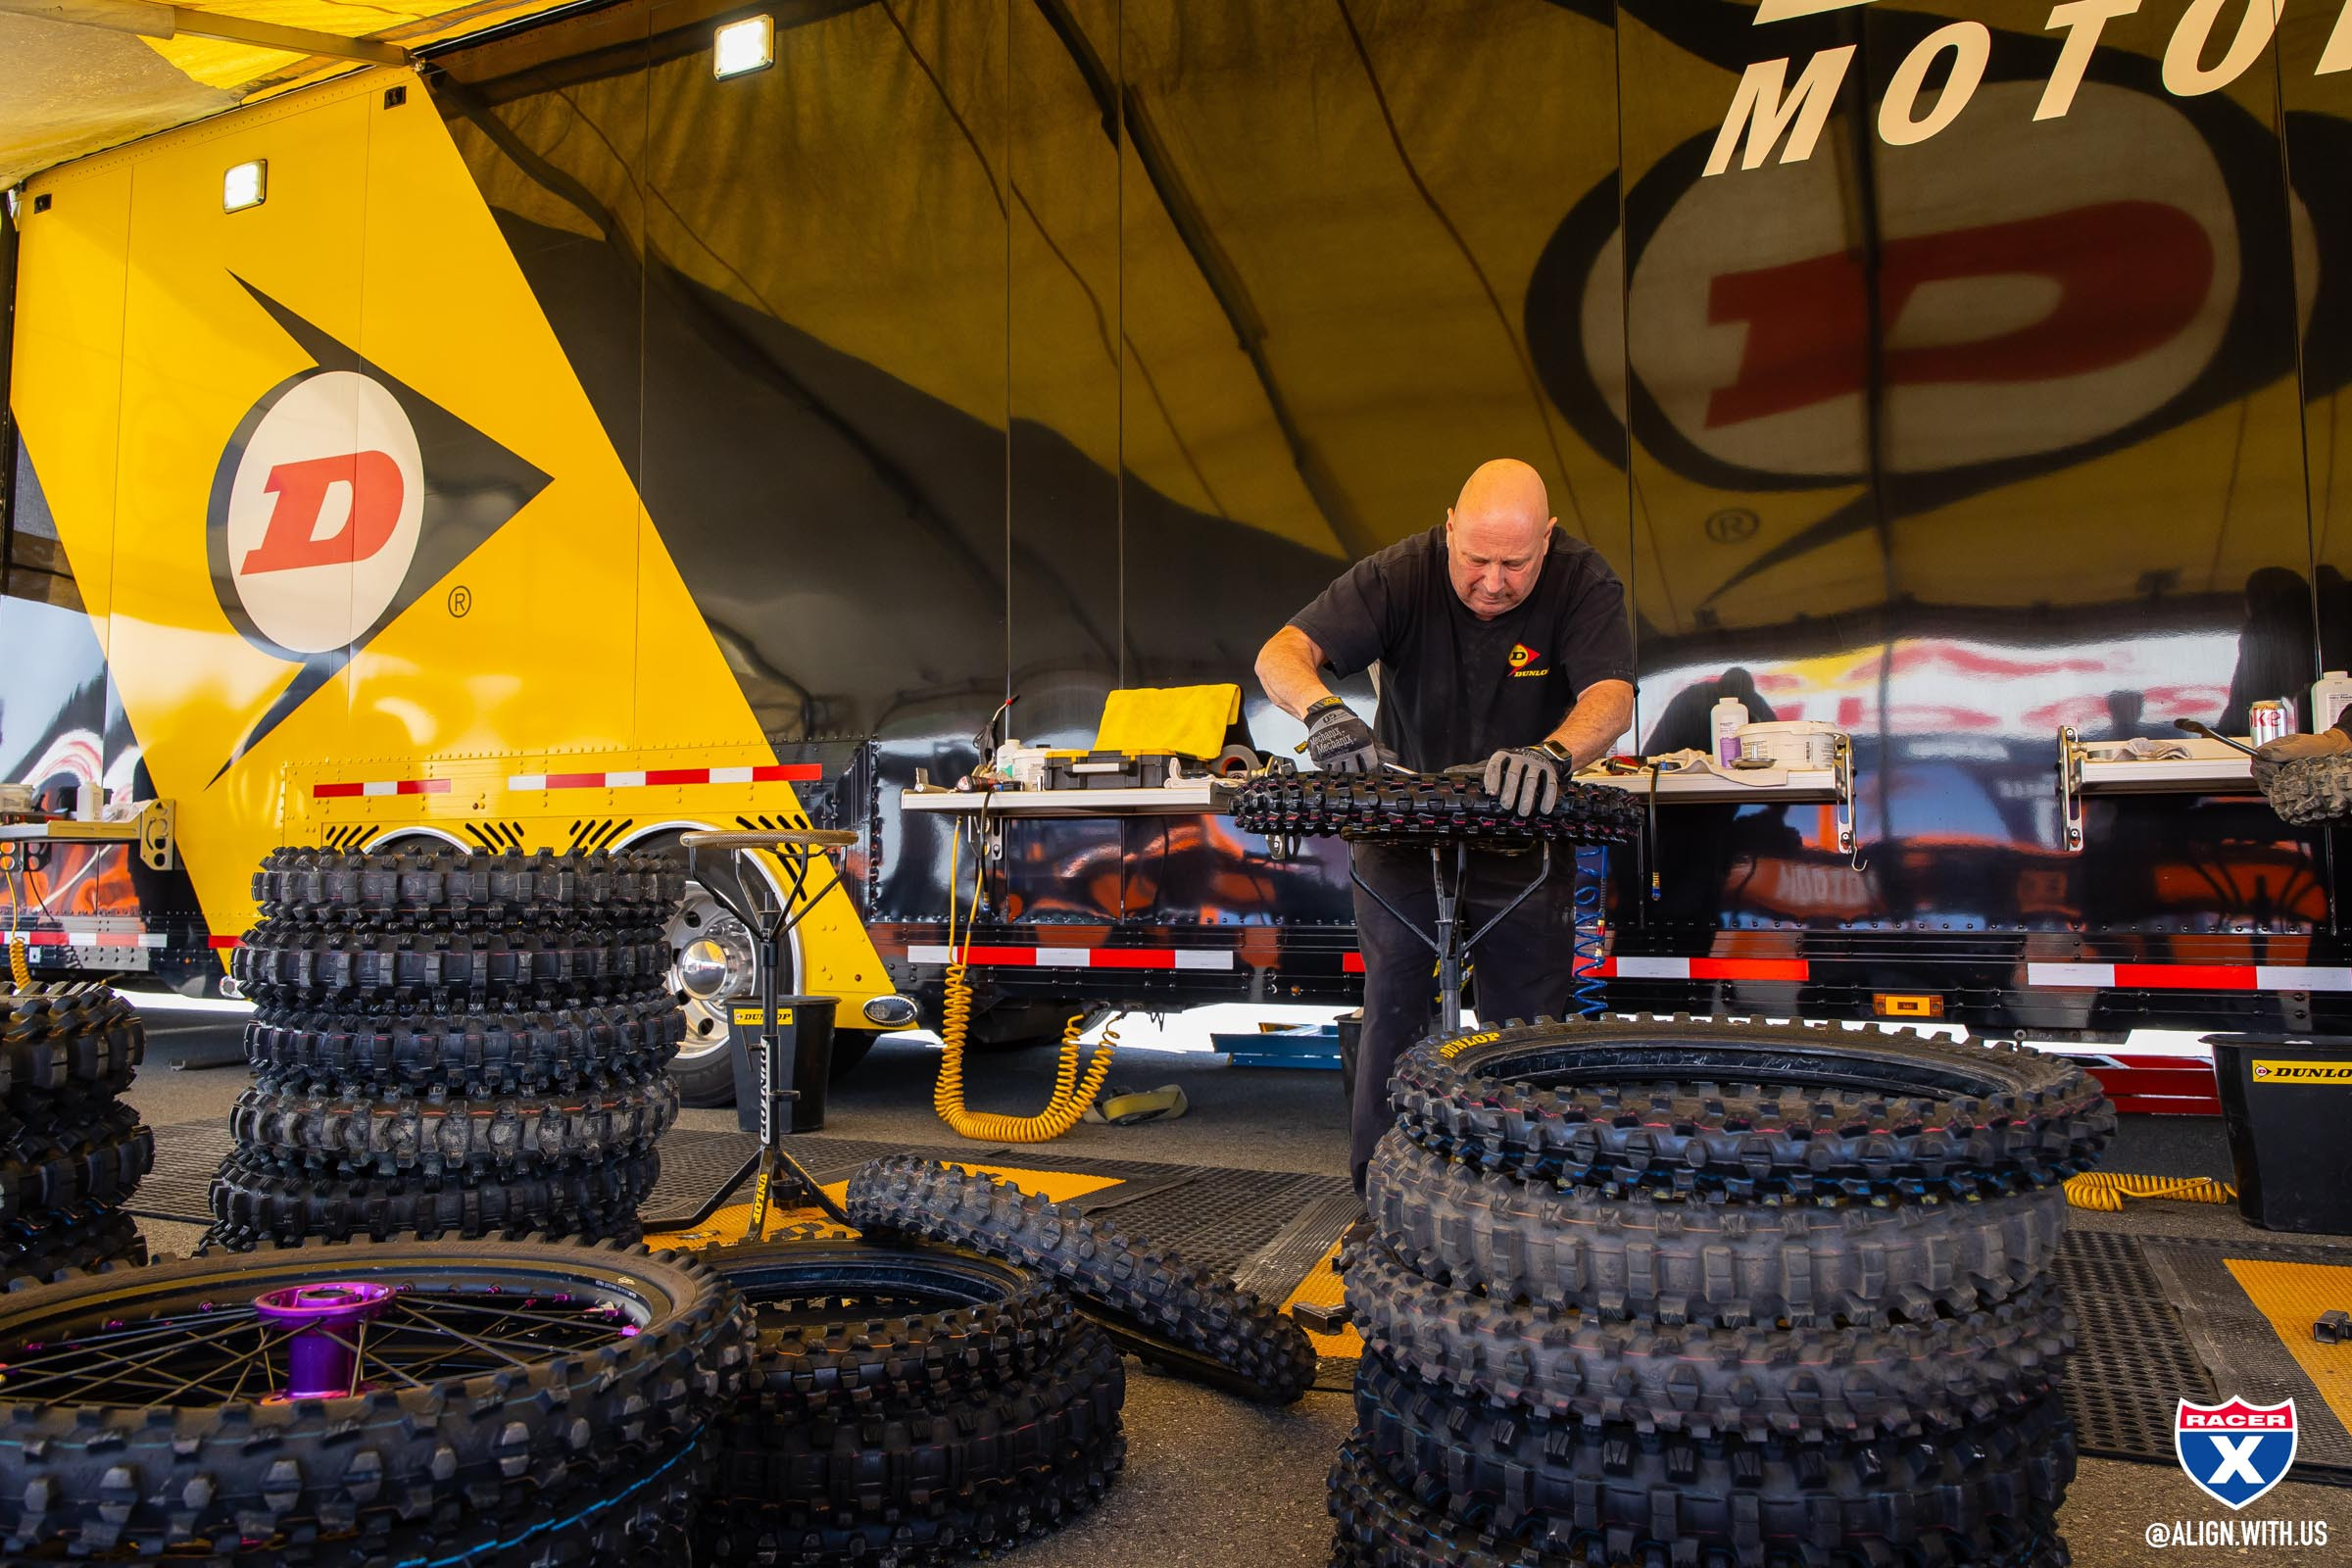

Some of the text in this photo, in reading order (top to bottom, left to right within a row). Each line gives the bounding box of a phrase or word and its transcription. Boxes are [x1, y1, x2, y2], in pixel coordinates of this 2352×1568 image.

[240, 450, 405, 575] D
[1510, 651, 1527, 661] D
[1514, 668, 1549, 677] DUNLO
[1440, 1031, 1500, 1059] DUNLOP
